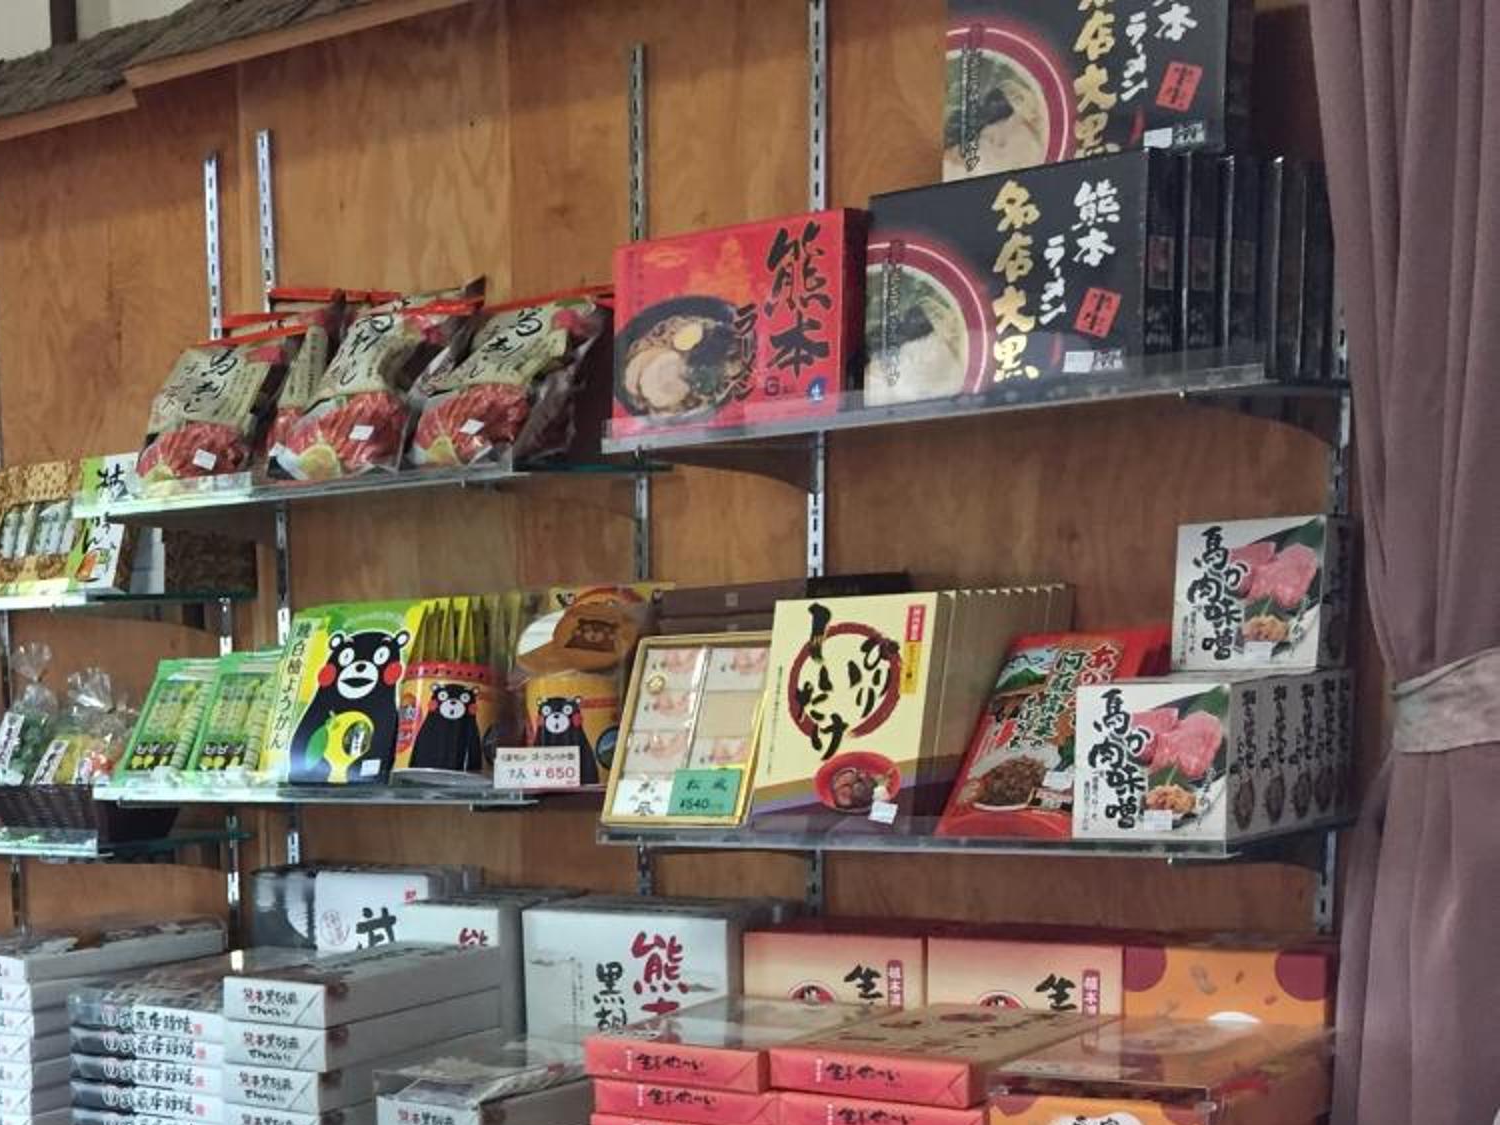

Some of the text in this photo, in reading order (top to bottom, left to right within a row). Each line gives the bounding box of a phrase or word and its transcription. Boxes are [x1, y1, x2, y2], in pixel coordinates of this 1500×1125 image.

[1120, 12, 1149, 102] ラーメン
[1072, 181, 1120, 264] 熊本
[764, 221, 833, 383] 熊本
[991, 179, 1040, 382] 名店大黒
[1037, 234, 1066, 325] ラーメン
